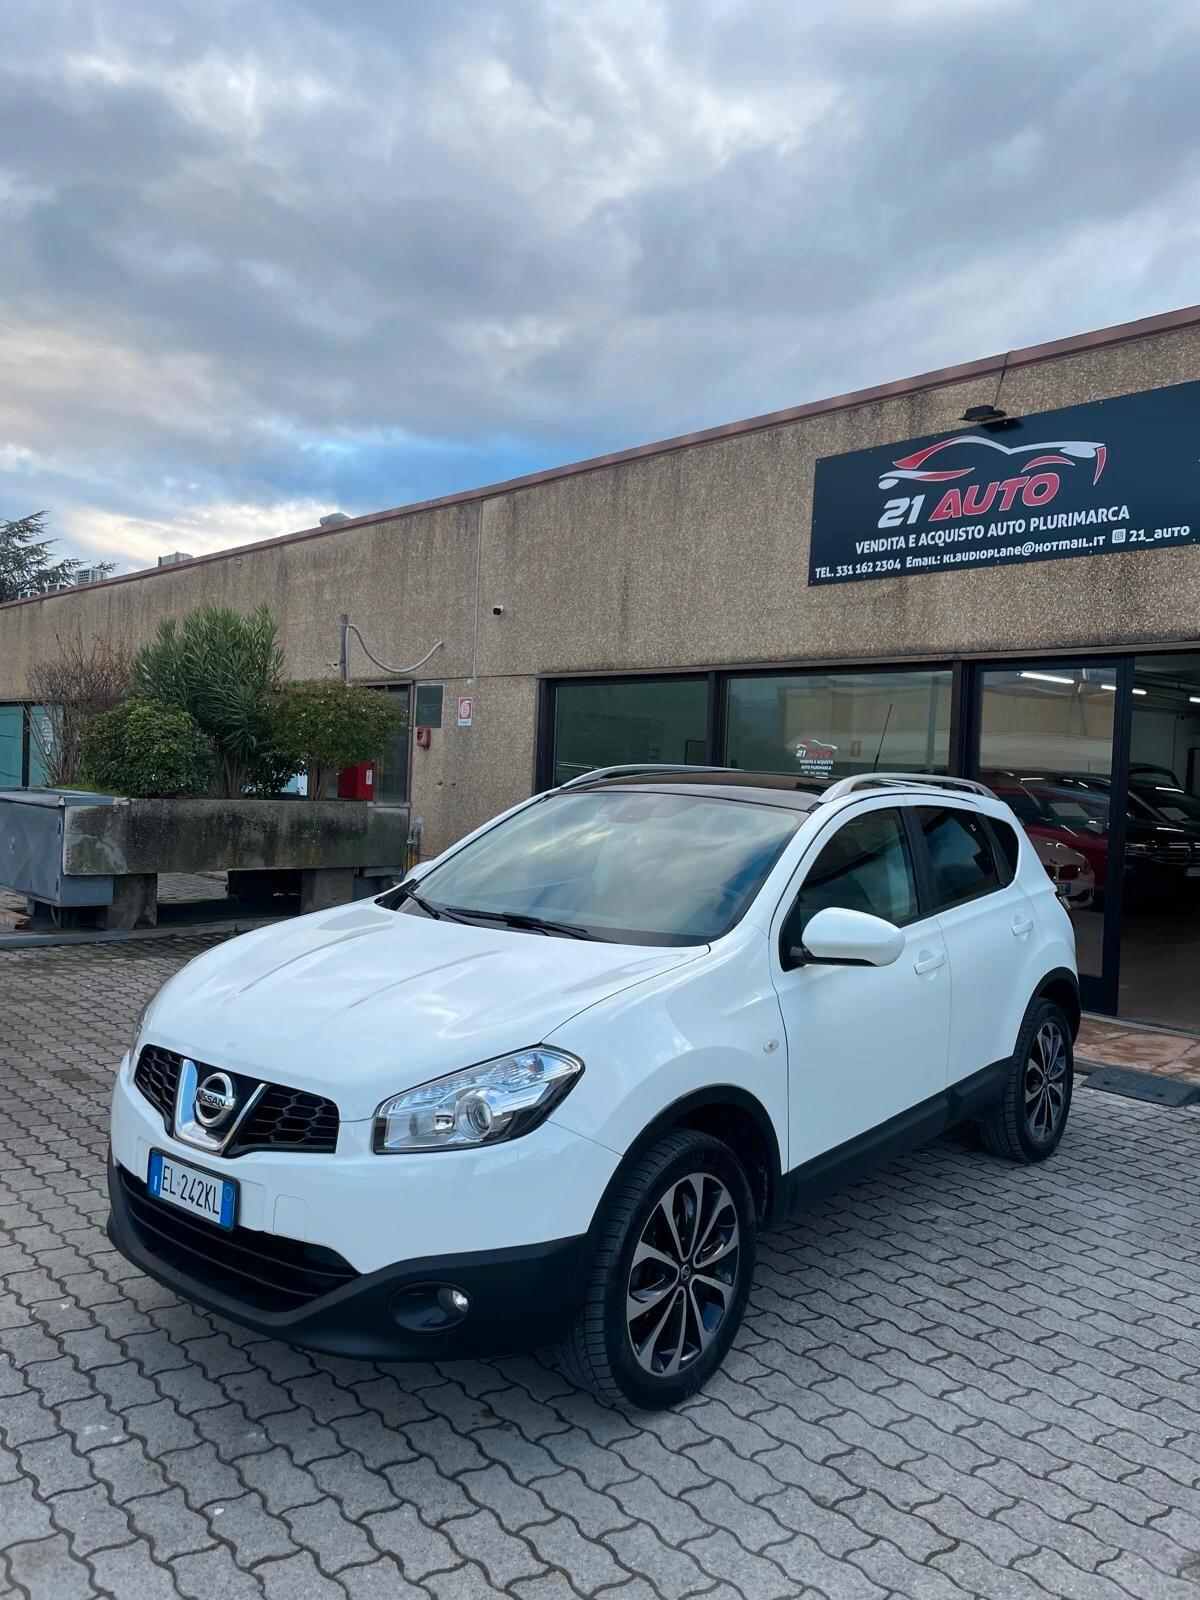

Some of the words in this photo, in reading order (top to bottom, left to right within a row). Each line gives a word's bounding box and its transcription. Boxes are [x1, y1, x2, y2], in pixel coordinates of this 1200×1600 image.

[877, 494, 925, 529] 21
[928, 472, 1060, 521] AUTO
[855, 536, 906, 555] VENDITA
[908, 534, 917, 548] E
[918, 525, 985, 547] ACQUISTO
[987, 519, 1026, 538] AUTO
[1030, 505, 1130, 533] PLURIMARCA
[815, 567, 835, 579] TEL.
[836, 564, 854, 577] 331
[856, 561, 874, 574] 162
[875, 558, 901, 572] 2304
